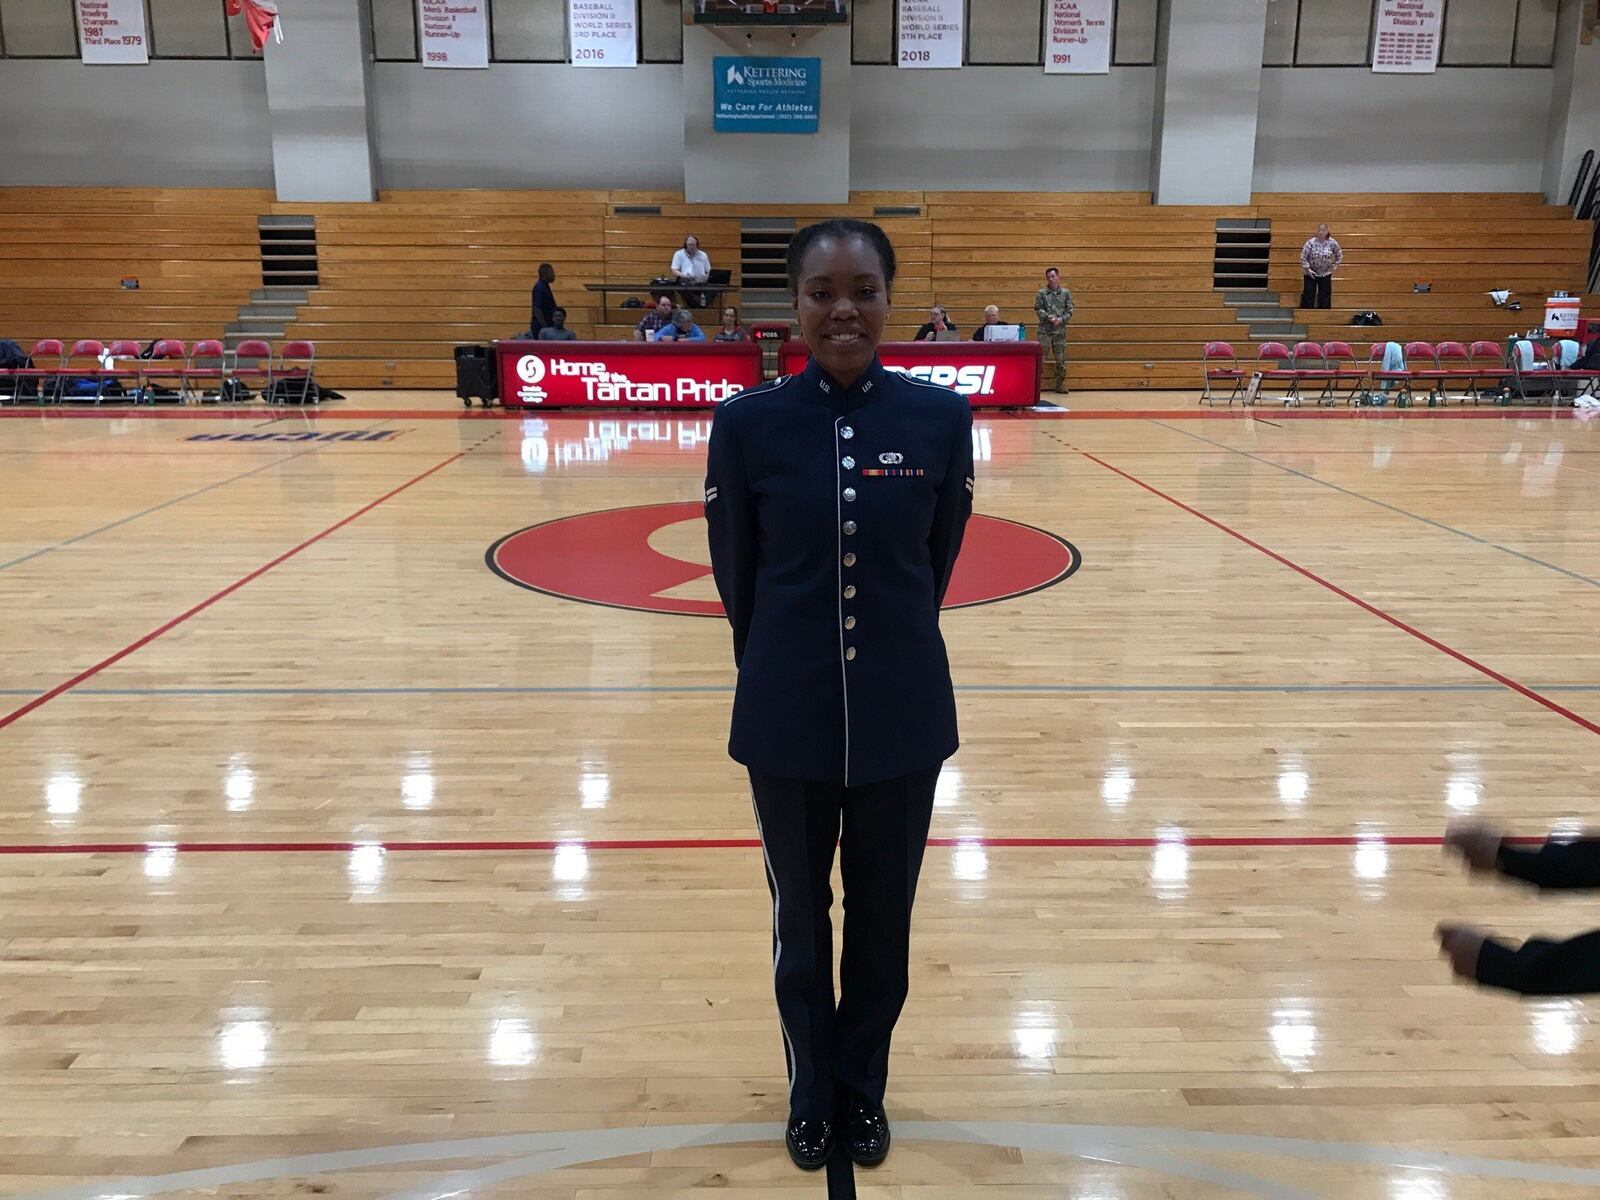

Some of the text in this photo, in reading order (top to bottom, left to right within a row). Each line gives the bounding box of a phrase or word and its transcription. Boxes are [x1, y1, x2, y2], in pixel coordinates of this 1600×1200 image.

[1397, 2, 1424, 10] National
[84, 27, 103, 37] 1981
[121, 35, 142, 46] 1979
[1052, 36, 1088, 44] Runner-Up
[427, 52, 448, 61] 1998
[575, 48, 605, 59] 2016
[901, 50, 930, 61] 2018
[1053, 54, 1071, 64] 1991
[743, 66, 807, 78] KETTERING
[747, 78, 807, 88] Sports Medicine
[720, 103, 814, 112] We Care For Athletes
[550, 358, 607, 376] Home
[581, 377, 744, 402] Tartan Pride
